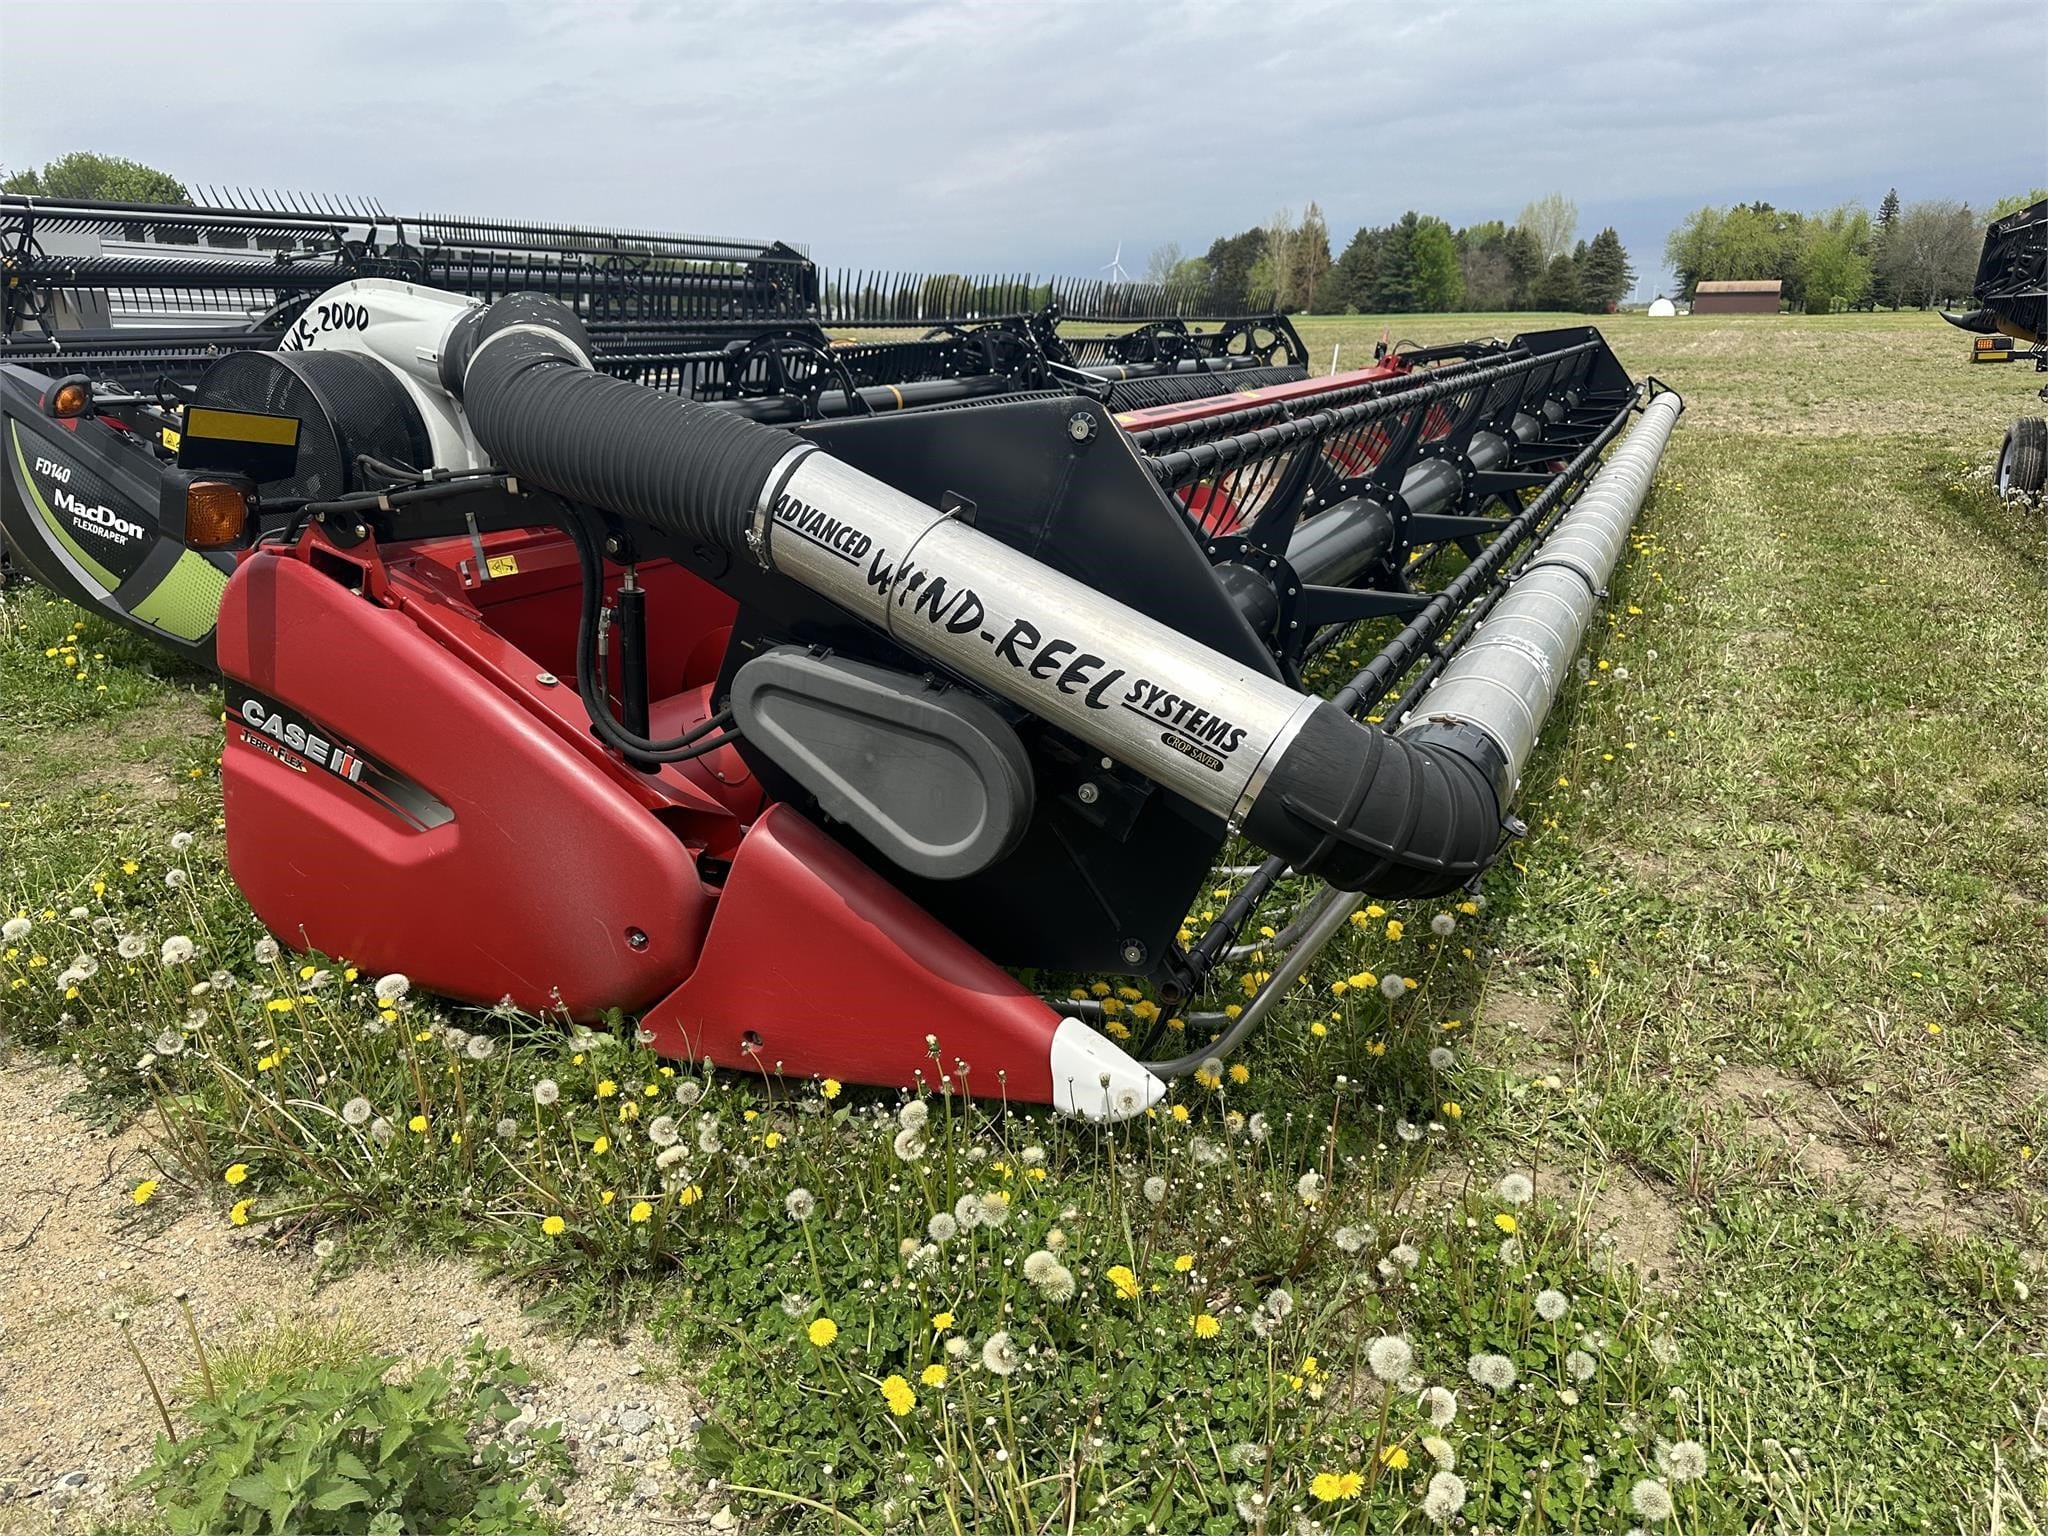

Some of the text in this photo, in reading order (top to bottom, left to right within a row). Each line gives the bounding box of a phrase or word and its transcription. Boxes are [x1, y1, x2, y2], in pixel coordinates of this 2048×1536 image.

[35, 457, 71, 483] FD140
[54, 488, 143, 539] MacDon
[73, 516, 126, 545] FLEXDRAPER
[773, 494, 1247, 752] ADVANCED WIND-REEL SYSTEMS
[240, 729, 305, 770] TERRA FLEX
[241, 699, 331, 765] CASE
[1167, 735, 1219, 770] CROP SAVER
